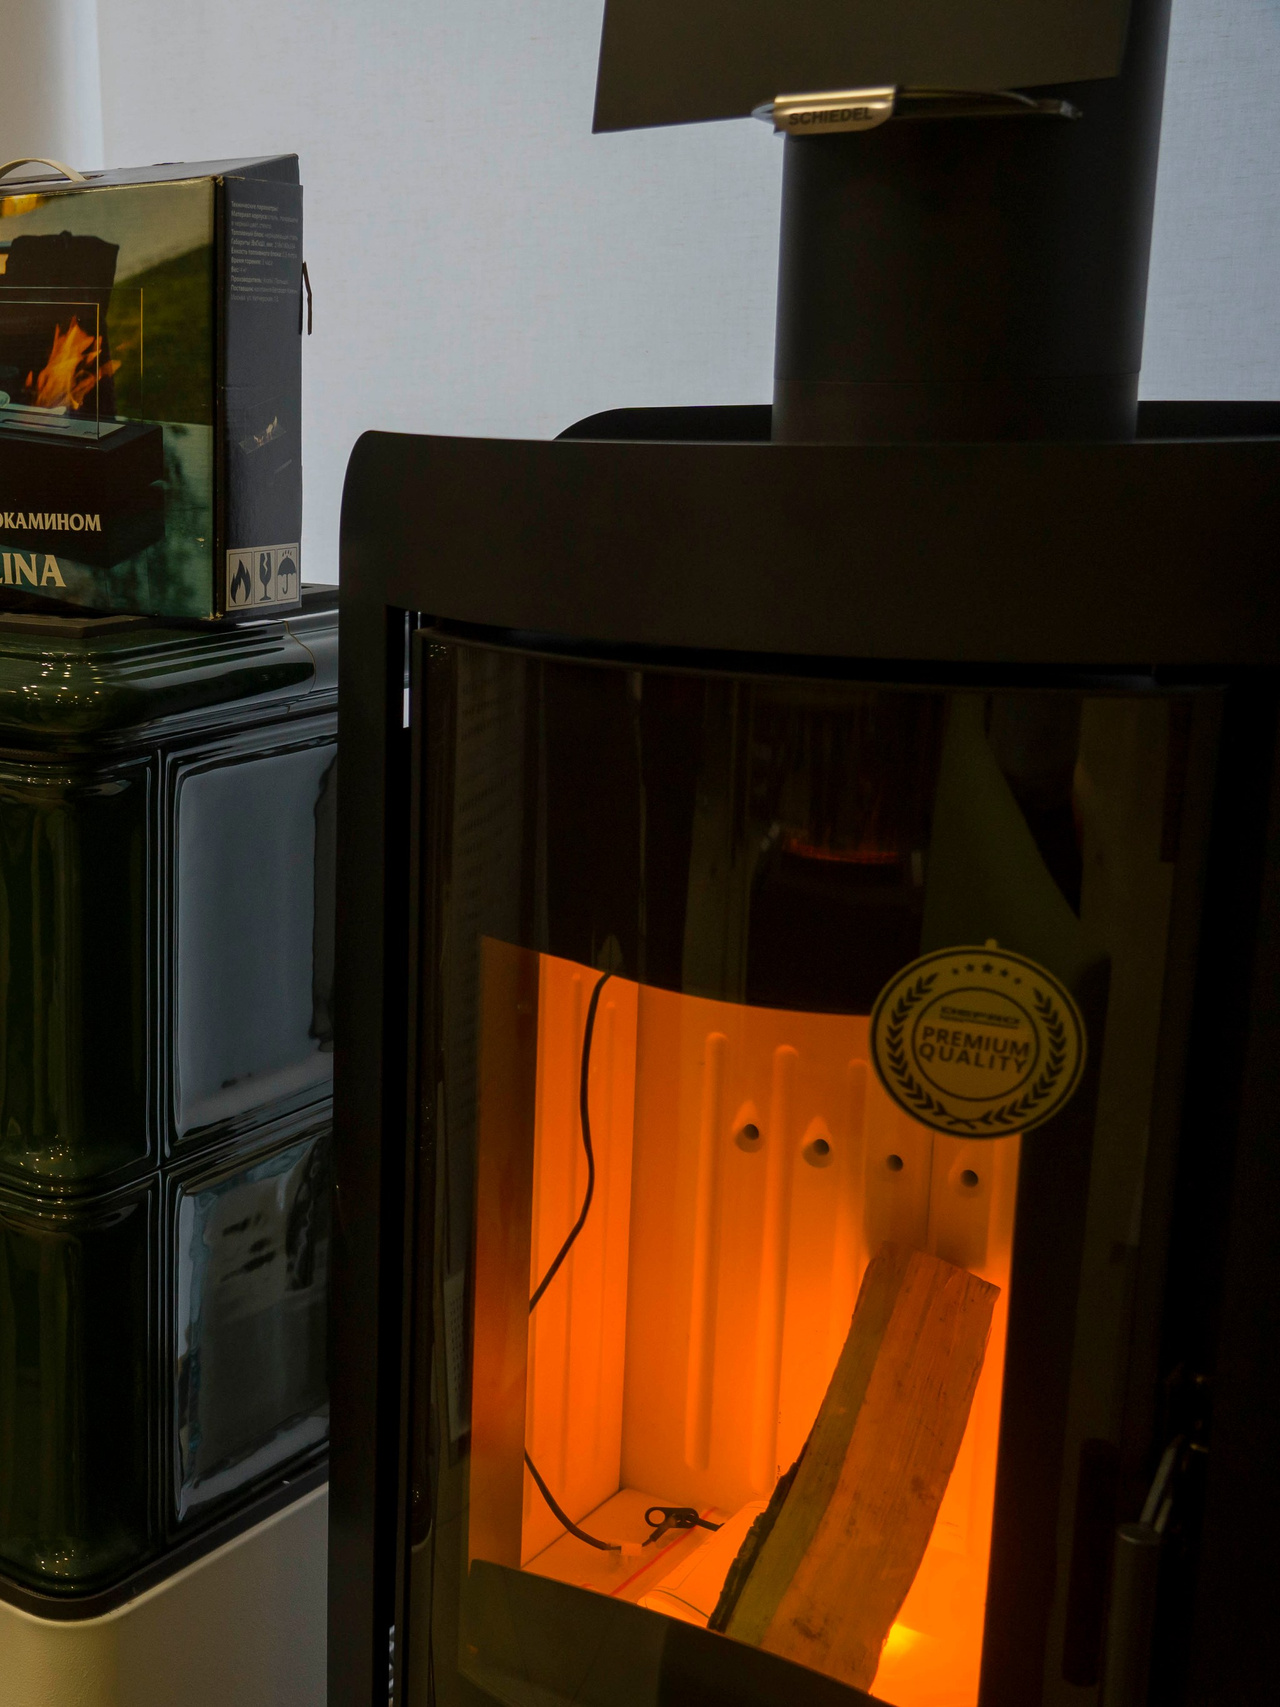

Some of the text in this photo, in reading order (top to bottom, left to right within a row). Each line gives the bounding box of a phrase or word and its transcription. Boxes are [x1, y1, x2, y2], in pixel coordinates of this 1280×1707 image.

[788, 106, 872, 126] SCHIEDEL
[922, 1025, 1030, 1058] PREMIUM
[918, 1043, 1027, 1074] QUALITY
